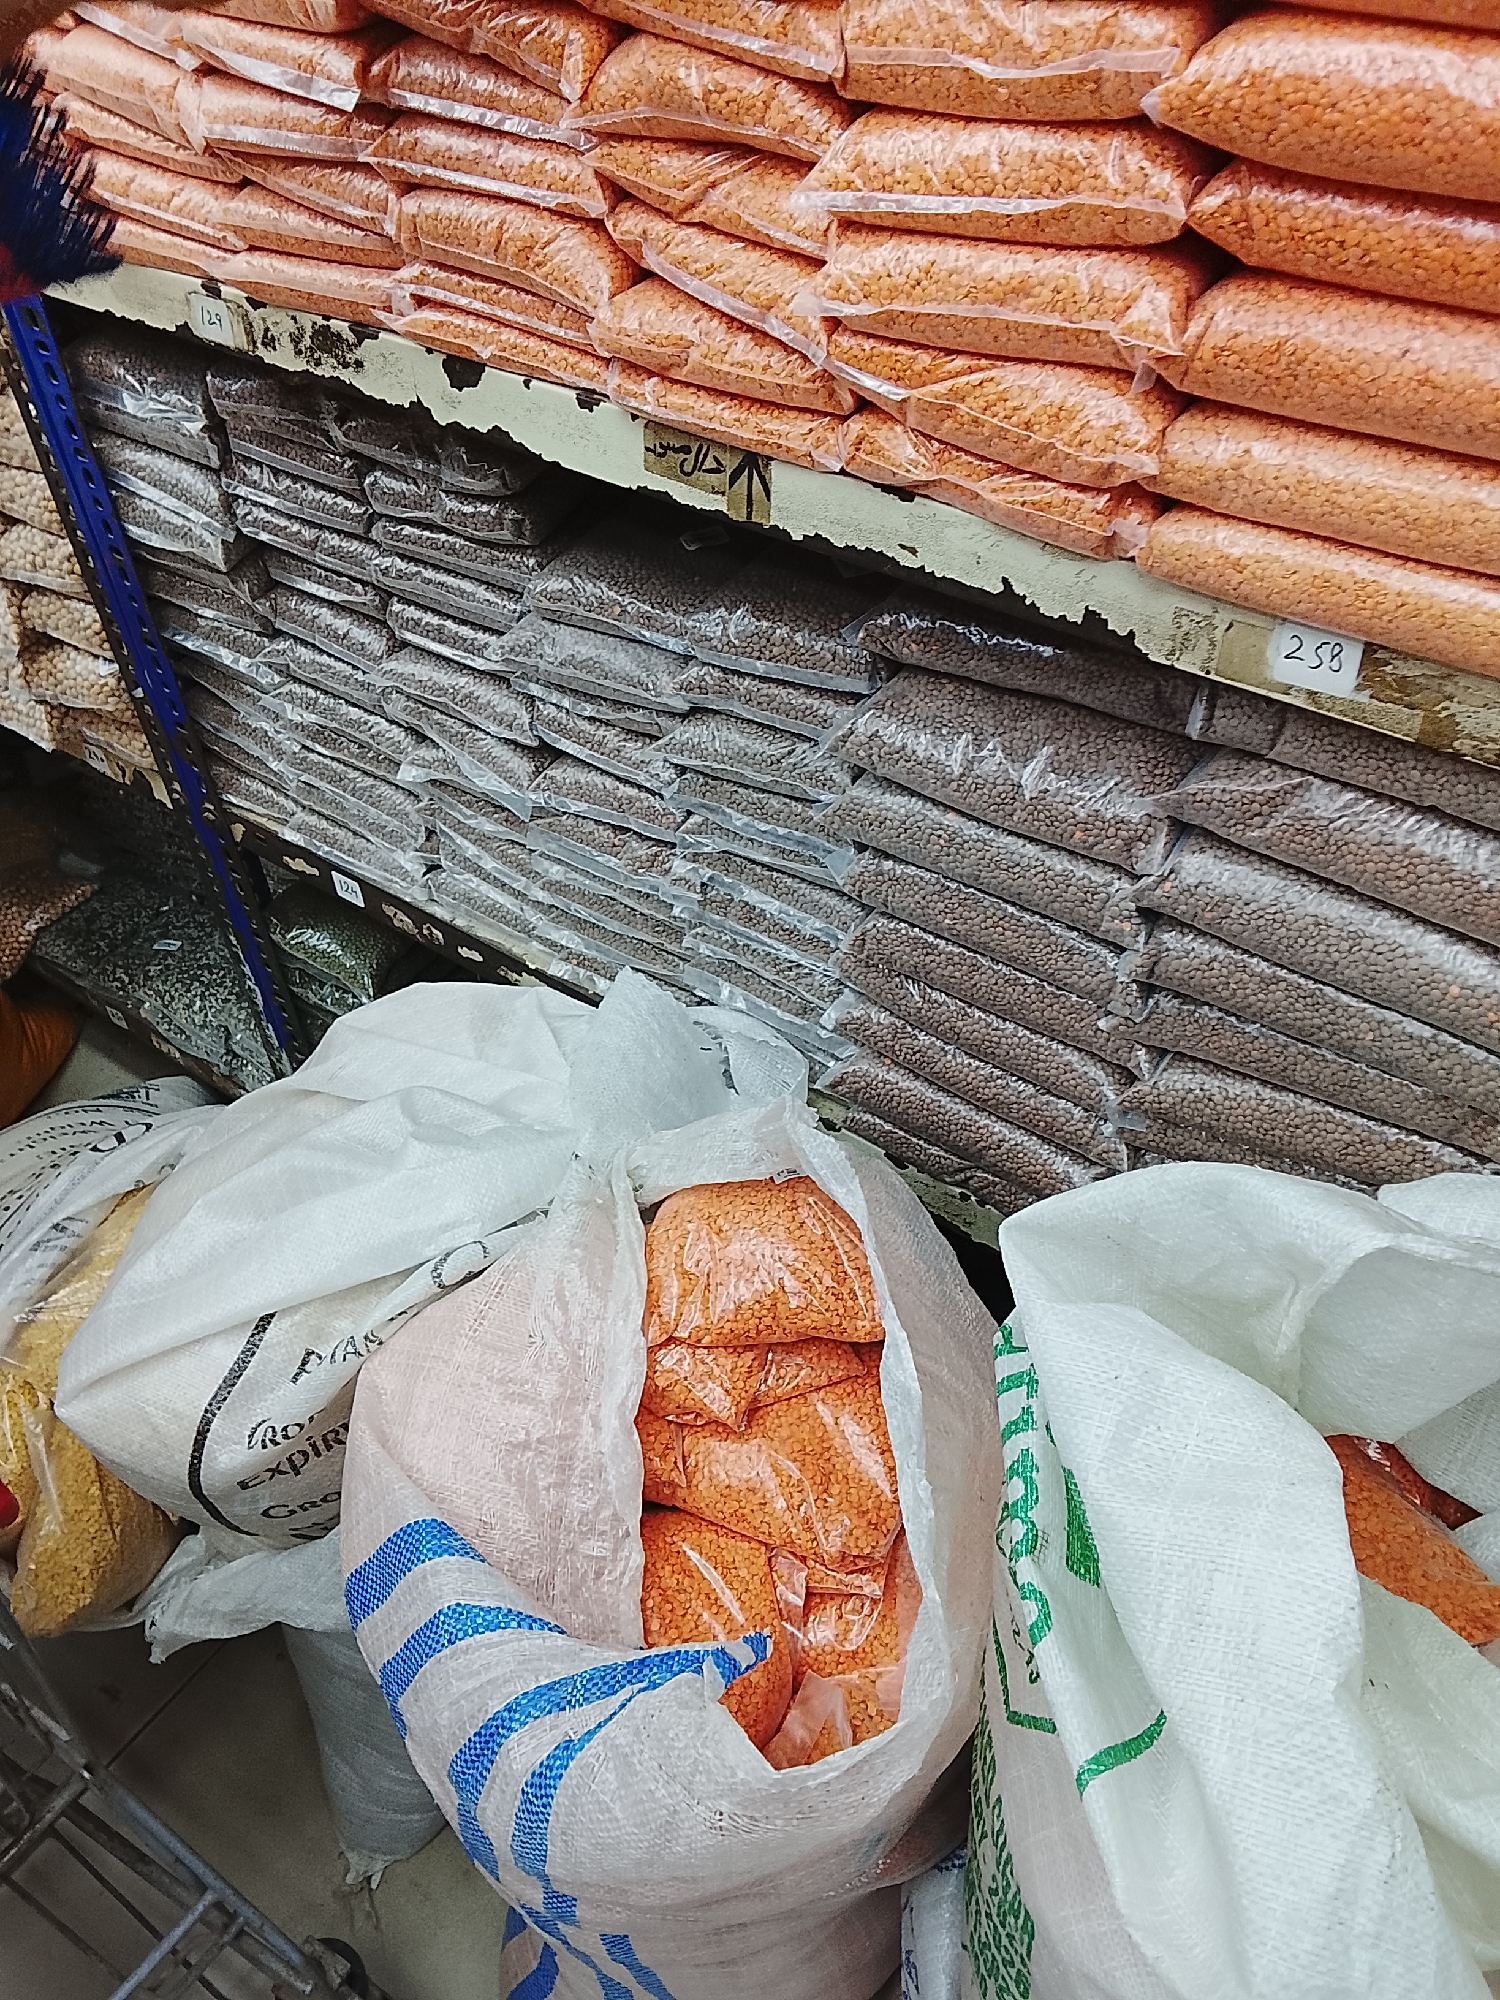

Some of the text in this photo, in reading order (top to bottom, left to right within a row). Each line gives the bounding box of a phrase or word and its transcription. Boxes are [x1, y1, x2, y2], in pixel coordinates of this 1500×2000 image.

[201, 305, 223, 331] 129
[1284, 634, 1344, 673] 258
[338, 880, 359, 899] 124
